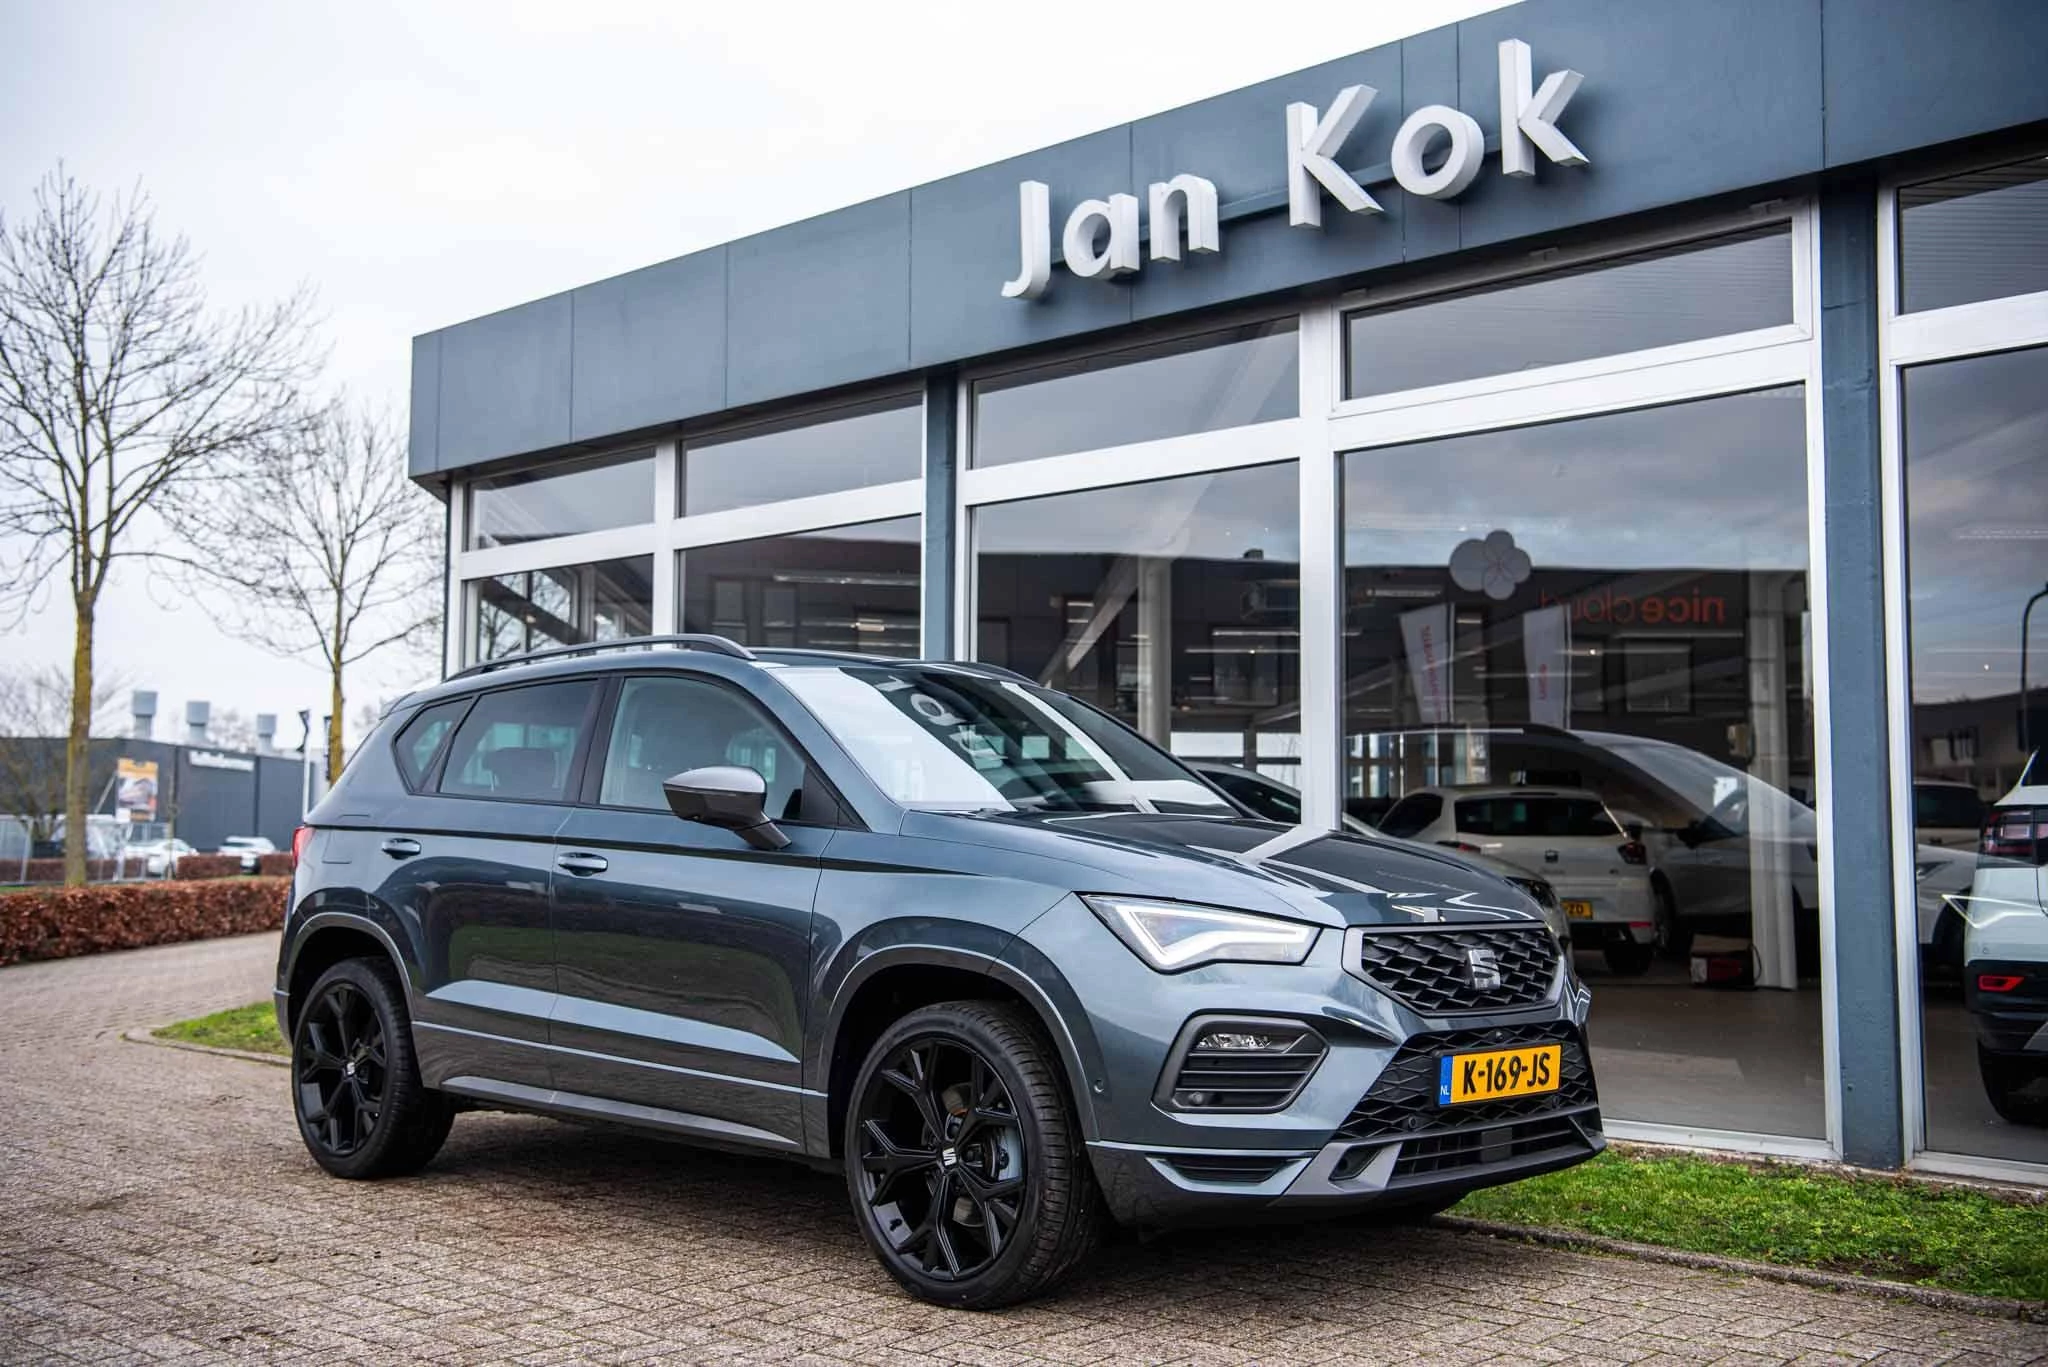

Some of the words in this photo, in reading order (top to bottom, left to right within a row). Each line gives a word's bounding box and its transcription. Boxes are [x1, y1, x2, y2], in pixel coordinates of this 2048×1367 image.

[1002, 174, 1219, 299] Jan
[1286, 38, 1591, 231] Kok
[1440, 1085, 1450, 1095] NL
[1463, 1052, 1551, 1095] K-169-JS
